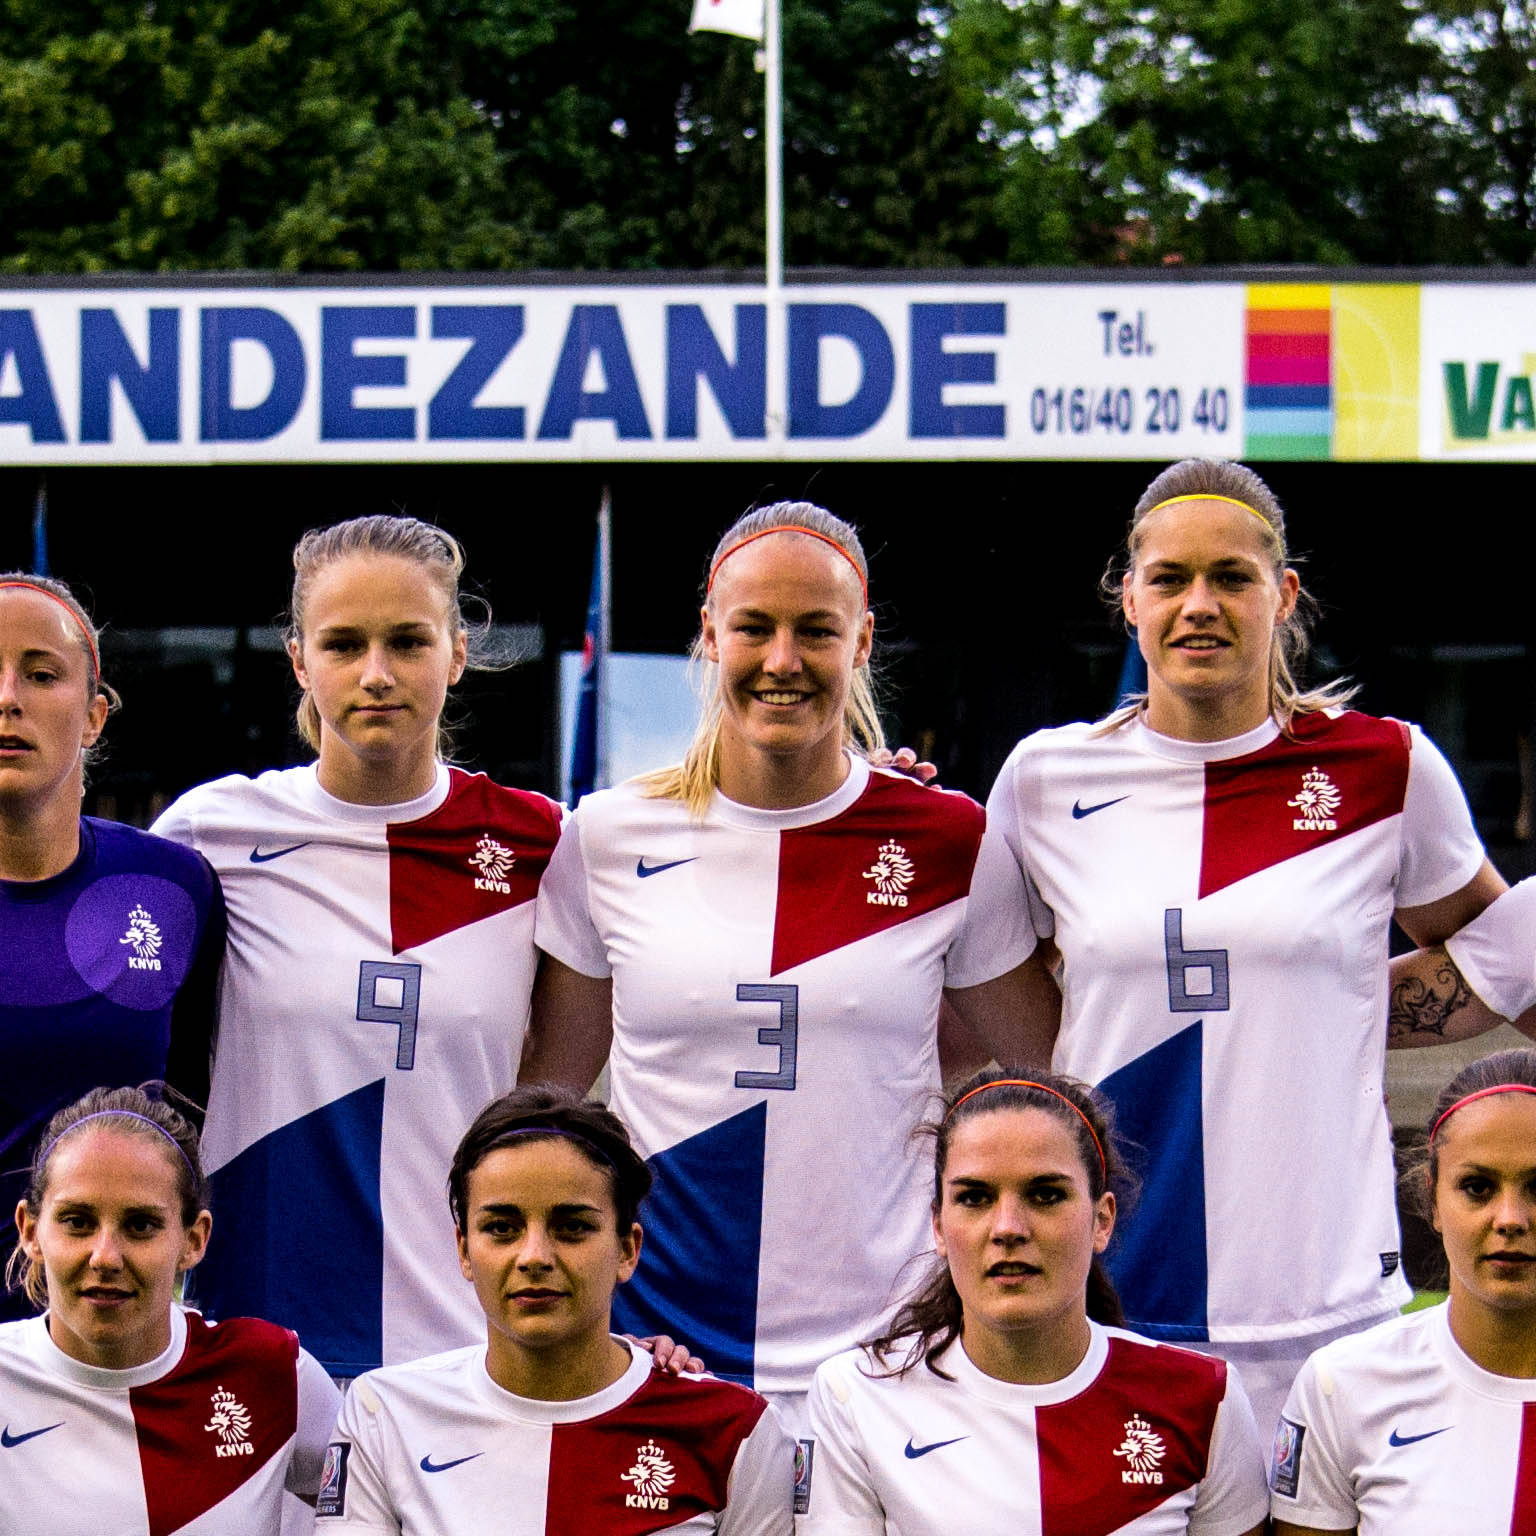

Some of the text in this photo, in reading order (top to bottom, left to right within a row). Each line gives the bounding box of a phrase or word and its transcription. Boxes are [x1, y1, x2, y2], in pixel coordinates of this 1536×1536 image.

[1097, 310, 1155, 356] Tel.
[1030, 387, 1228, 434] 016/40 20 40
[1292, 819, 1338, 832] KNVB
[474, 877, 512, 895] KNVB
[866, 891, 909, 908] KNVB
[128, 956, 162, 972] KNVB
[1164, 908, 1230, 1012] 6
[356, 960, 422, 1070] 9
[734, 983, 799, 1090] 3
[215, 1442, 255, 1459] KNVB
[1121, 1470, 1164, 1486] KNVB
[625, 1493, 670, 1511] KNVB
